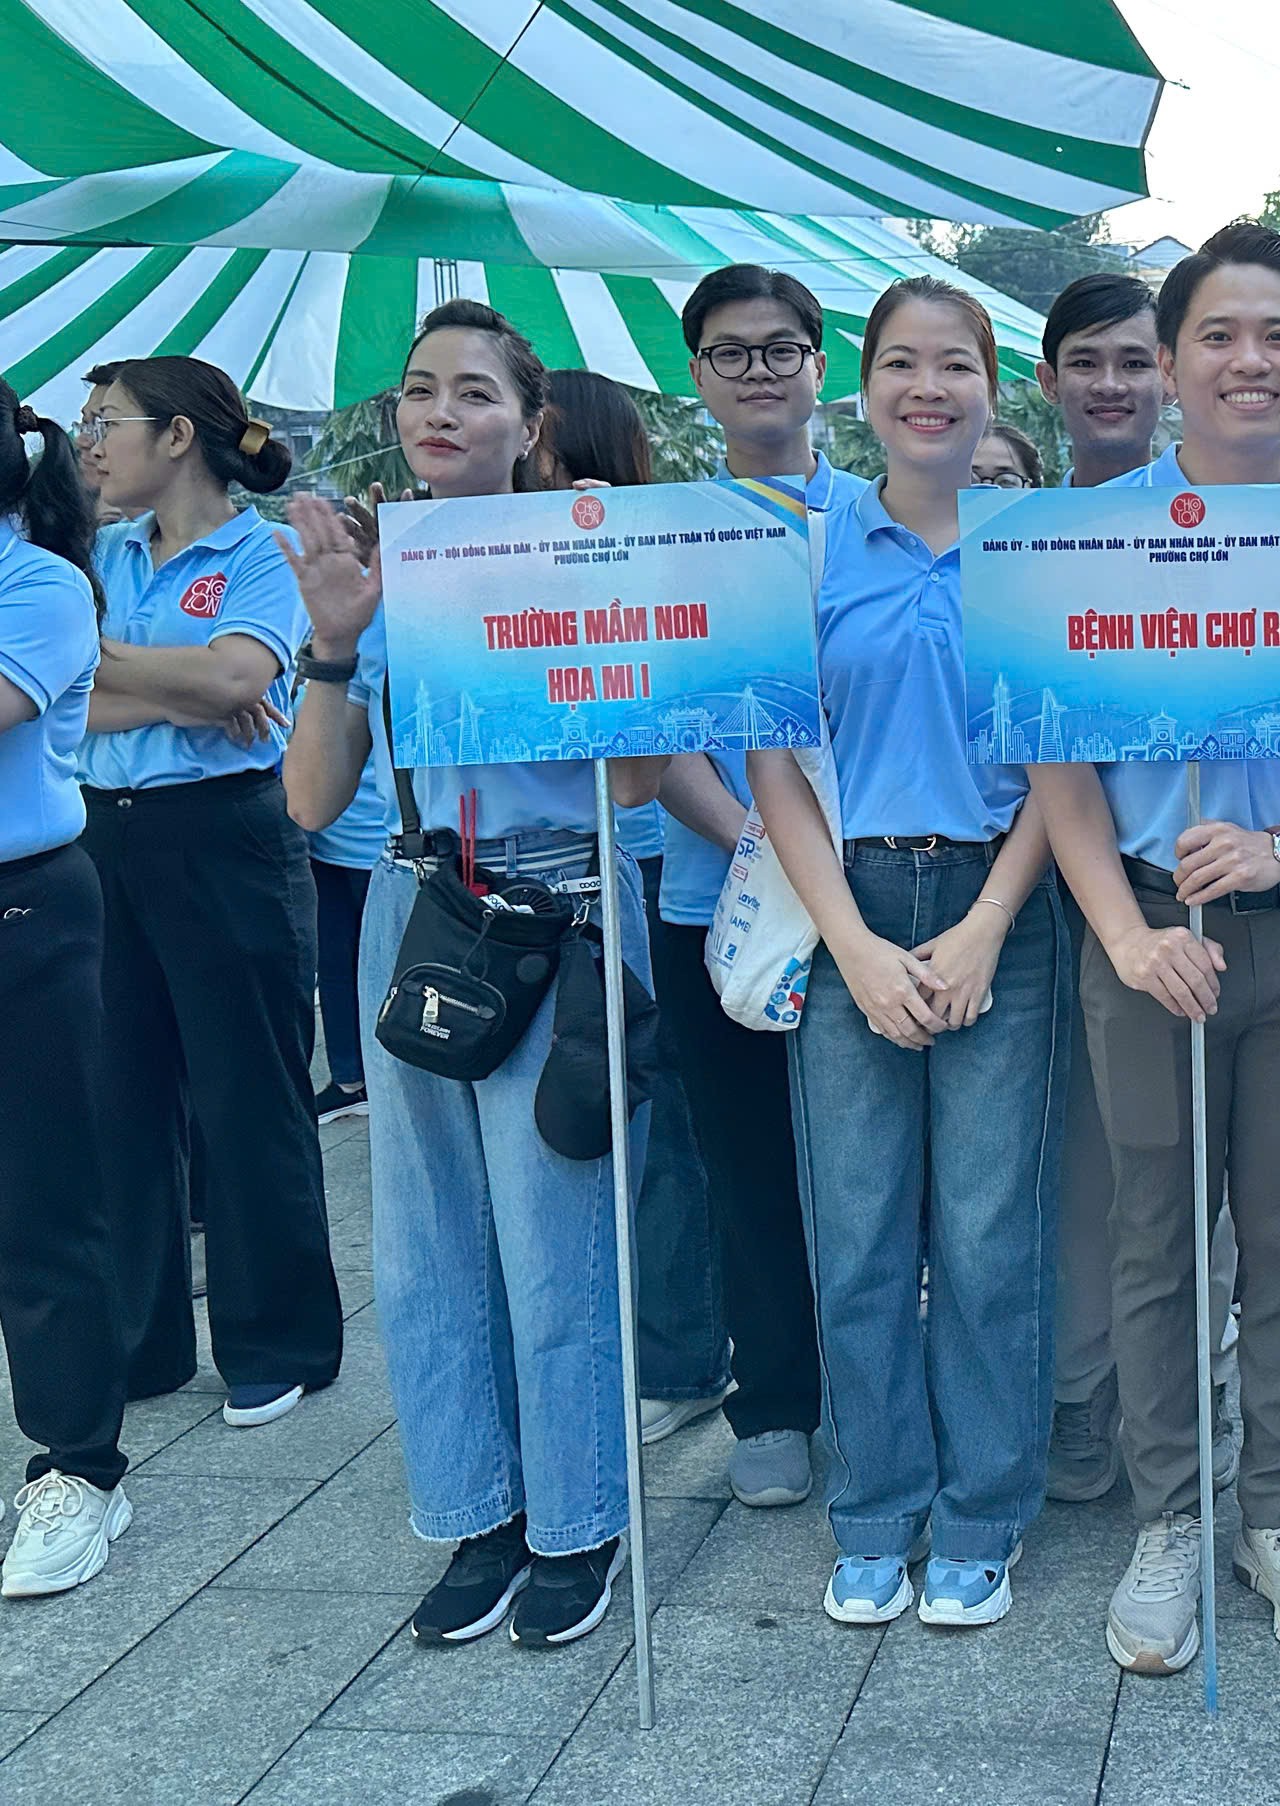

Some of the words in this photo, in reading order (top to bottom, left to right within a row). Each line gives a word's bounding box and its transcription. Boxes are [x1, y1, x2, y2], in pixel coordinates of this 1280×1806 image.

[445, 549, 460, 560] HỘI
[462, 544, 486, 558] ĐỒNG
[488, 543, 511, 556] NHÂN
[513, 542, 531, 554] DÂN
[552, 541, 570, 552] BAN
[572, 538, 596, 550] NHÂN
[598, 536, 616, 549] DÂN
[638, 535, 656, 546] BAN
[678, 530, 702, 545] TRẬN
[718, 527, 743, 542] QUỐC
[744, 527, 764, 542] VIỆT
[766, 527, 787, 538] NAM
[592, 550, 610, 563] CHỢ
[1031, 539, 1048, 552] HỘI
[1050, 536, 1075, 550] ĐỒNG
[1078, 537, 1104, 550] NHÂN
[1106, 537, 1125, 549] DÂN
[1148, 538, 1167, 549] BAN
[1169, 536, 1194, 548] NHÂN
[1196, 535, 1216, 548] DÂN
[1239, 536, 1258, 547] BAN
[1189, 551, 1209, 563] CHỢ
[1211, 549, 1229, 561] LỚN
[483, 605, 578, 650] TRƯỜNG
[584, 598, 649, 645] MẦM
[654, 602, 709, 641] NON
[1067, 608, 1134, 659] BỆNH
[1140, 607, 1198, 657] VIỆN
[1205, 607, 1256, 656] CHỢ
[547, 666, 596, 710] HỌA
[600, 664, 636, 701] MI
